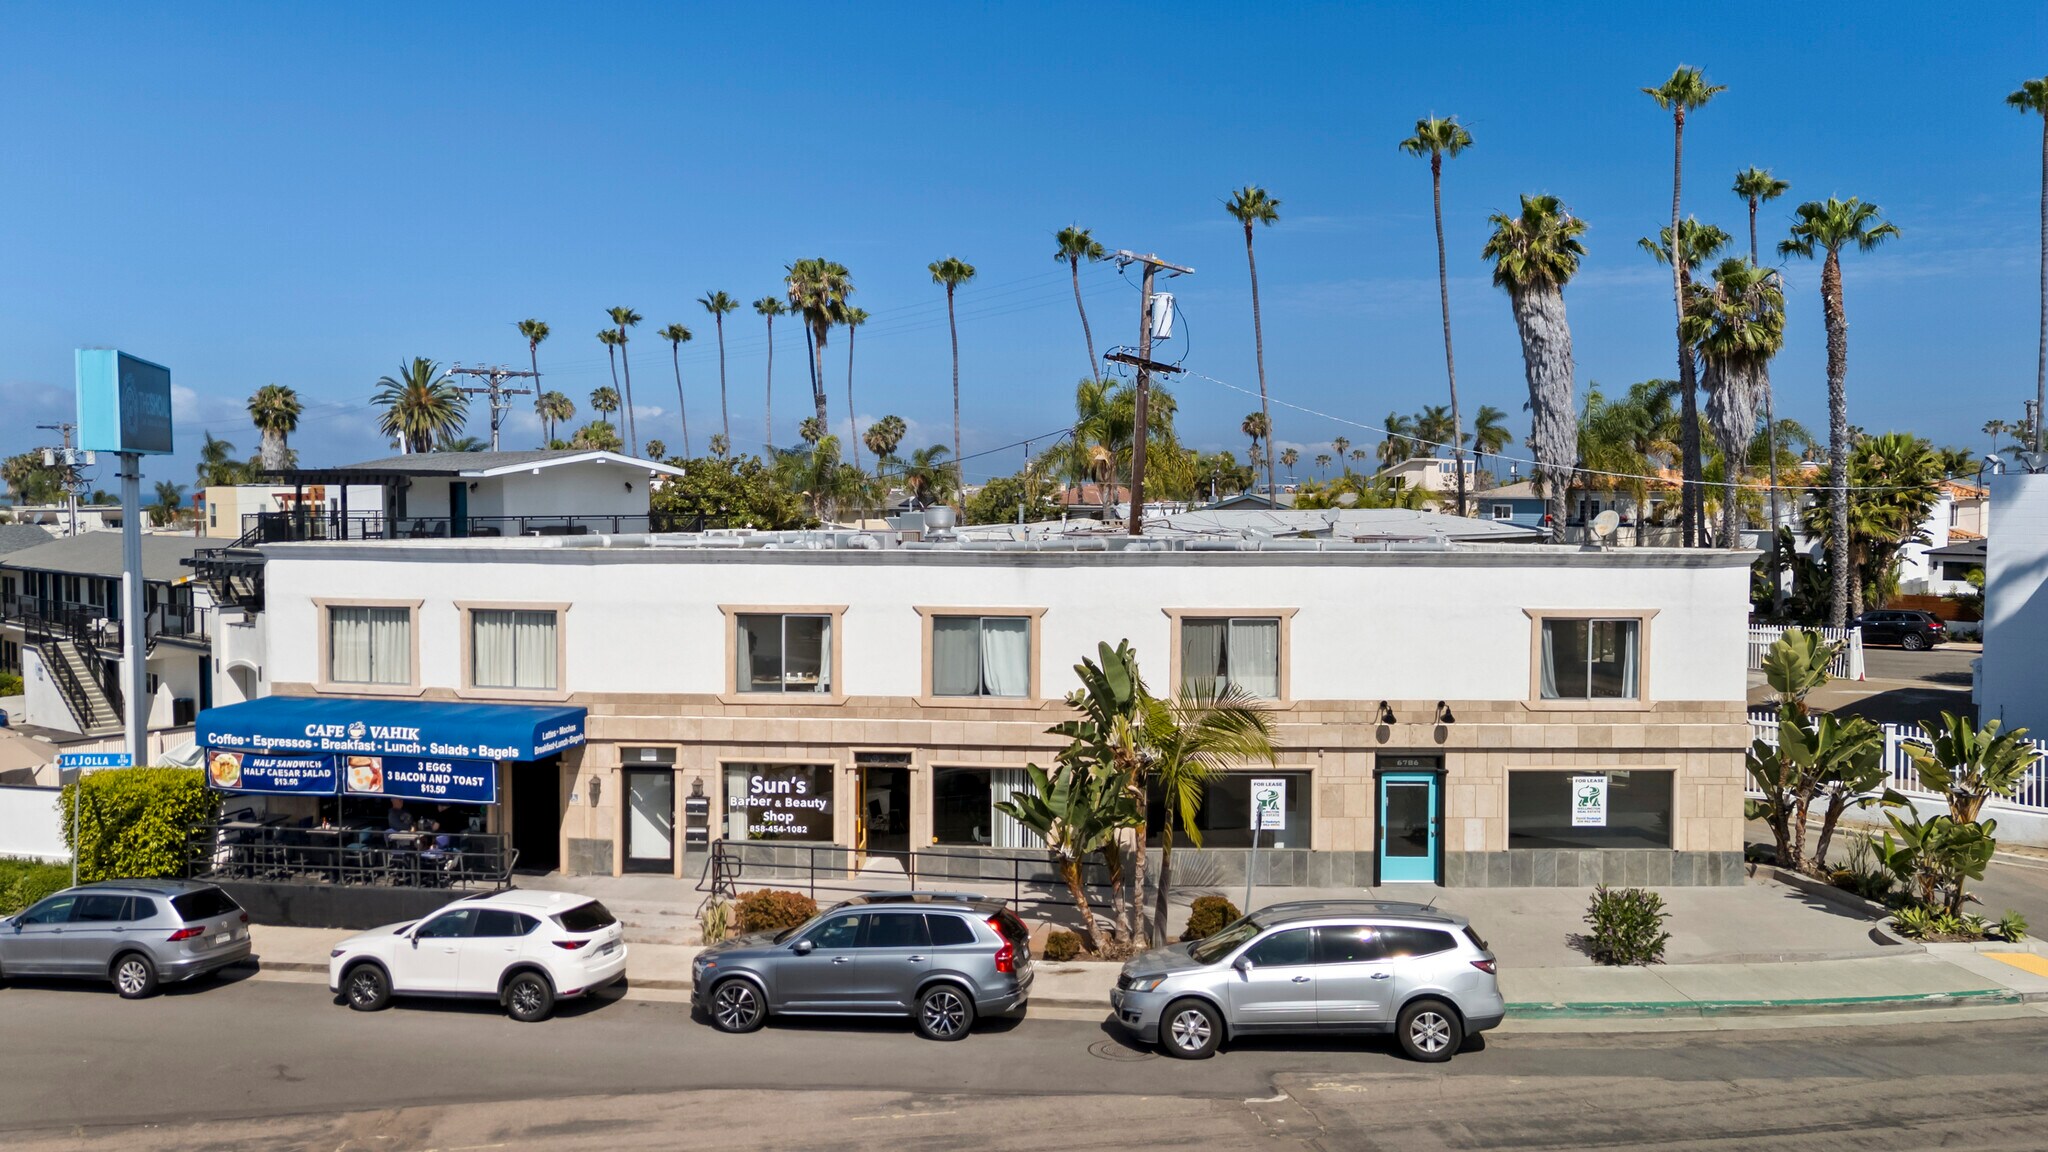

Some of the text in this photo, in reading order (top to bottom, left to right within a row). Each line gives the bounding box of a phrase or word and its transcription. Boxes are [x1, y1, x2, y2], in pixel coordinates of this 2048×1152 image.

[305, 724, 420, 741] CAFE VAHIK
[207, 732, 519, 760] Coffee Espressos Breakfast Lunch Salads Bagels
[64, 755, 109, 766] LA JOLLA
[253, 758, 322, 769] HALF SANDWICH
[243, 767, 331, 778] HALF CAESAR SALAD
[418, 762, 452, 773] 3 EGGS
[387, 772, 484, 787] 3 BACON AND TOAST
[750, 775, 807, 794] Sun's
[421, 784, 446, 794] $13.50
[730, 795, 827, 811] Barber & Beauty
[471, 818, 478, 827] A
[763, 810, 794, 824] Shop
[749, 825, 808, 834] 858-454-1082
